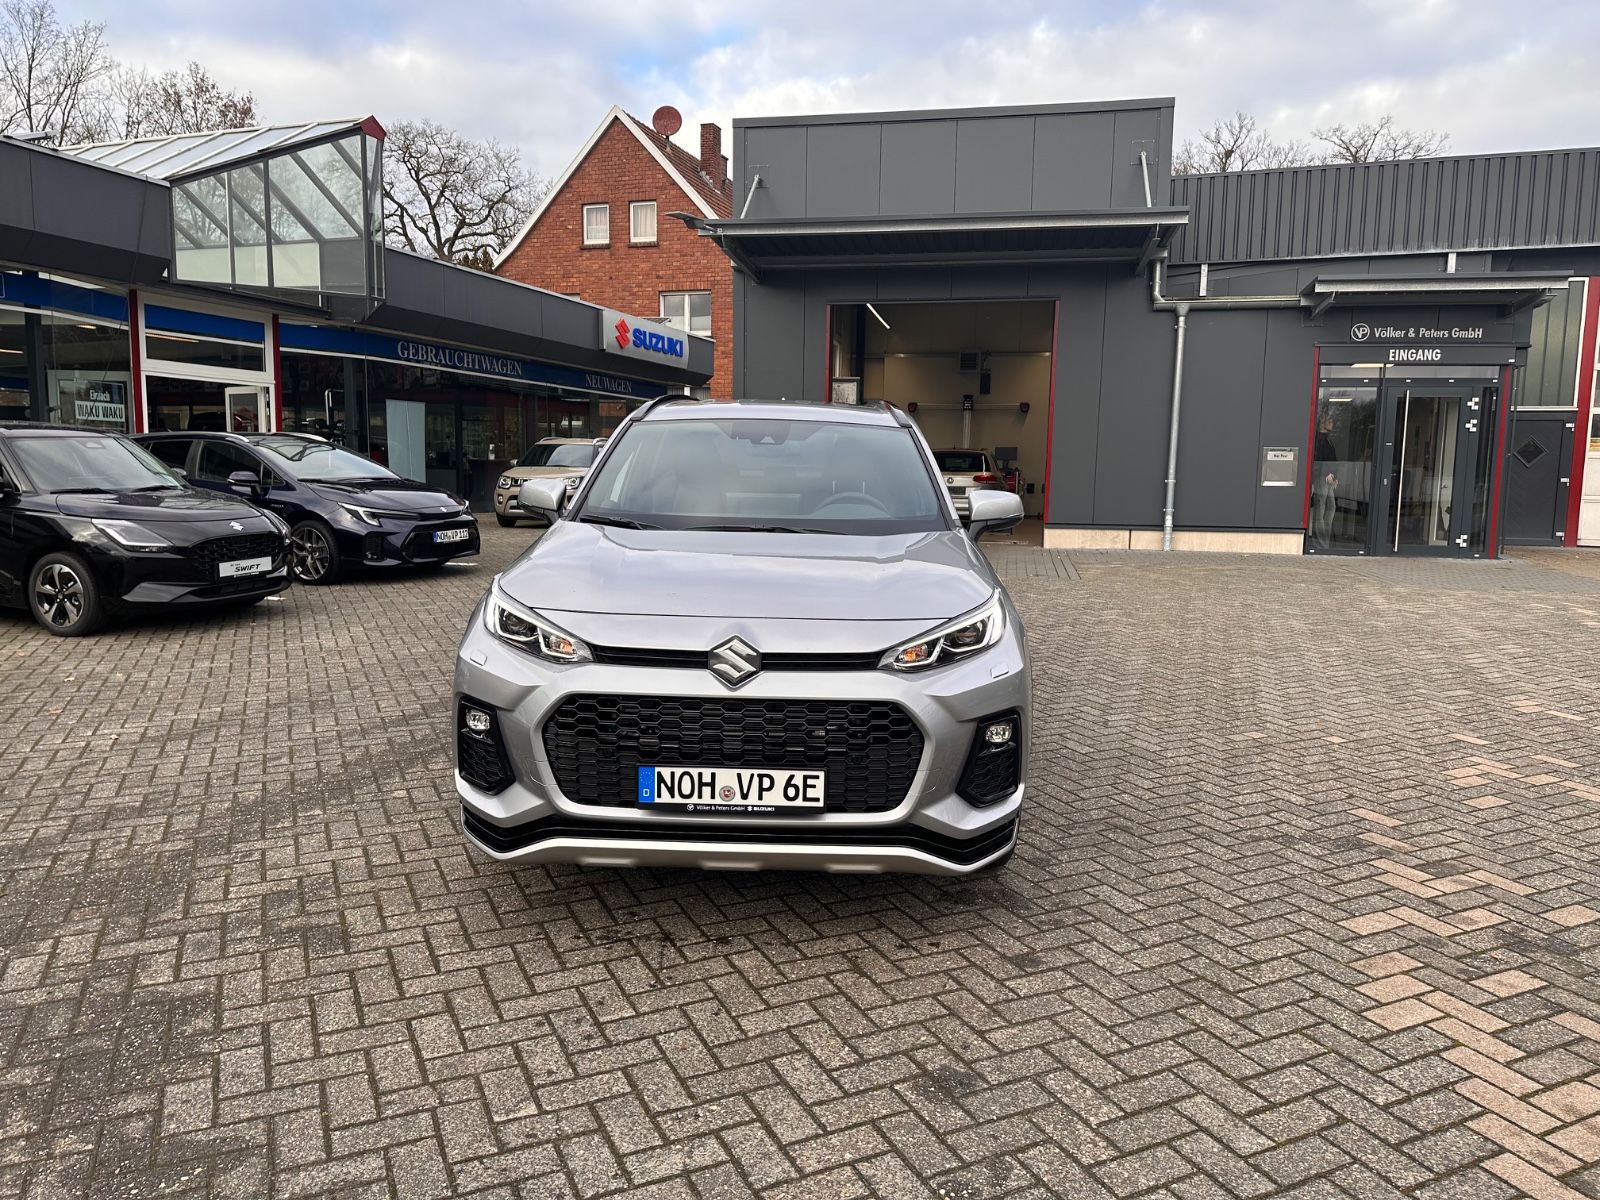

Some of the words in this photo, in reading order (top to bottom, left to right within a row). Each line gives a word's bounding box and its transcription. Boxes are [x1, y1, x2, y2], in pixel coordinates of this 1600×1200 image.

[1374, 327, 1406, 338] Völker
[1408, 328, 1415, 338] &
[1419, 328, 1449, 339] Peters
[1451, 328, 1483, 339] GmbH
[632, 327, 684, 358] SUZUKI
[397, 341, 522, 376] GEBRAUCHTWAGEN
[1389, 349, 1441, 361] EINGANG
[585, 374, 632, 393] NEUWAGEN
[77, 403, 100, 418] WAKU
[101, 405, 123, 420] WAKU
[234, 563, 261, 573] SWIFT
[643, 788, 650, 797] D
[656, 771, 716, 799] NOH
[736, 773, 775, 801] VP
[783, 774, 820, 803] 6E
